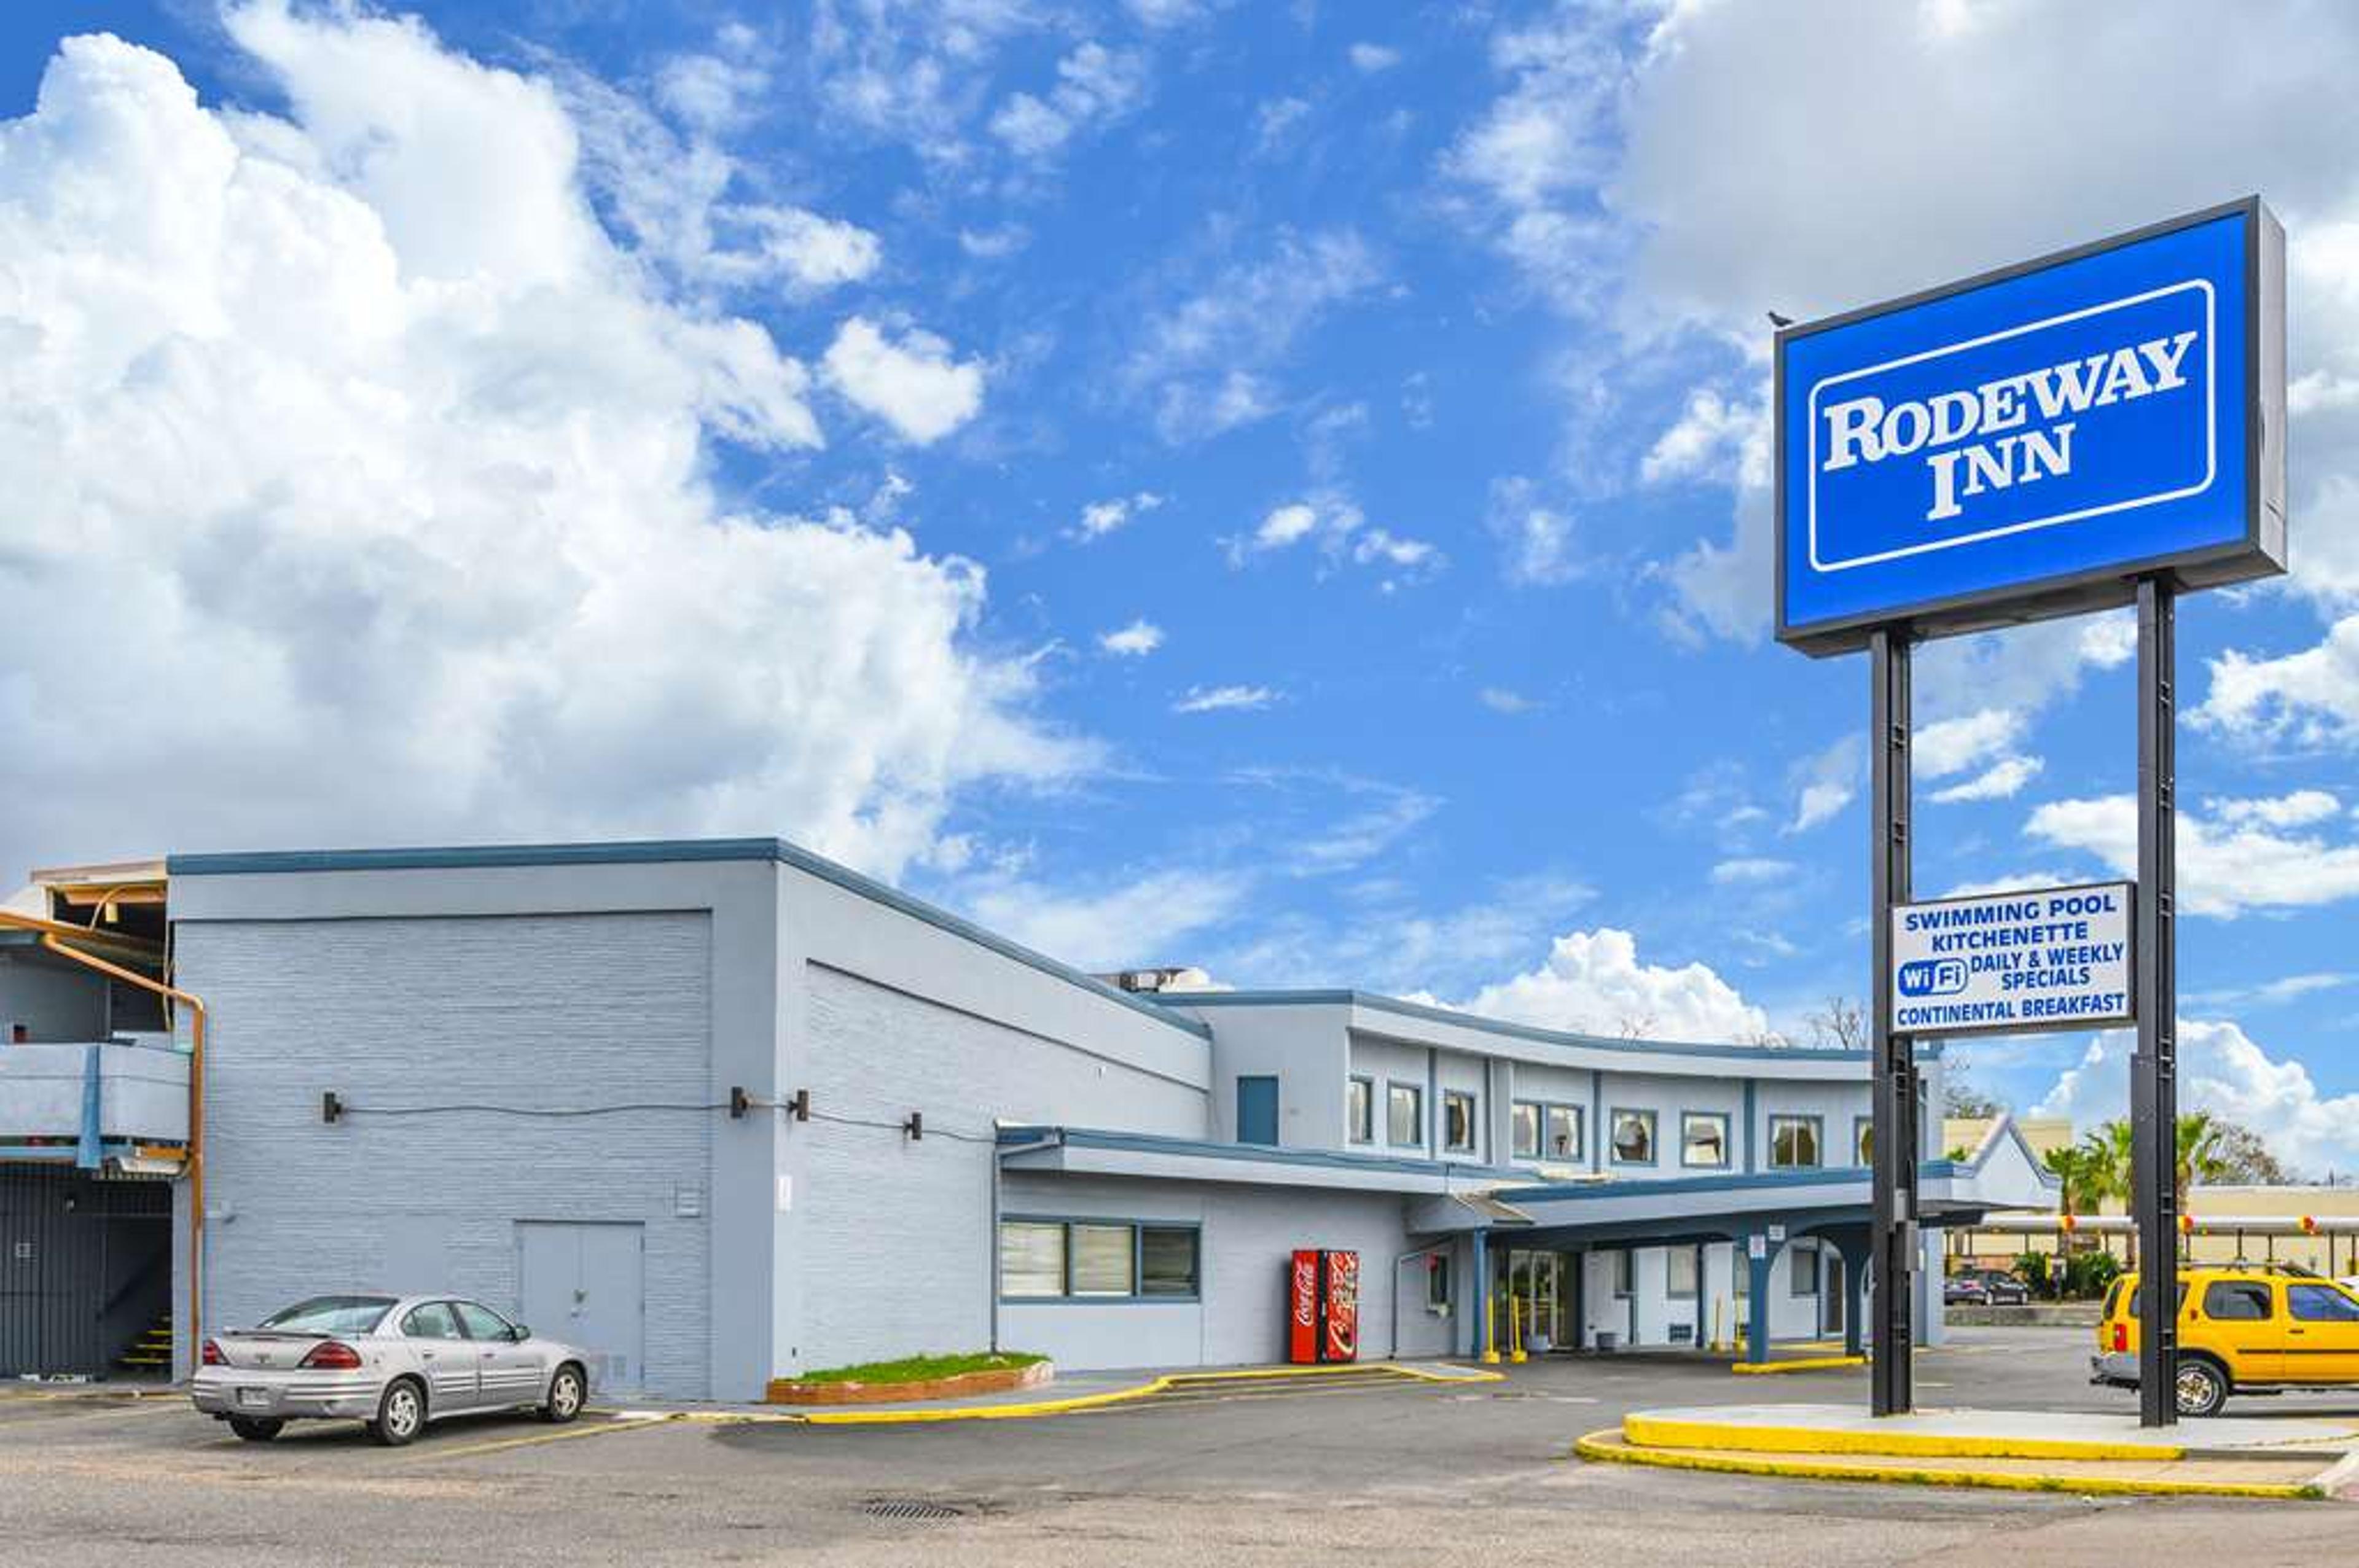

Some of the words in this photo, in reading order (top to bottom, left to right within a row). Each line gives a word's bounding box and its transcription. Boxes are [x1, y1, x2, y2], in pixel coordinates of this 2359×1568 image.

[1823, 331, 2198, 471] RODEWAY
[1927, 423, 2076, 521] INN
[1905, 901, 2040, 932] SWIMMING
[2049, 895, 2118, 917] POOL
[1931, 921, 2089, 953] KITCHENETTE
[1971, 952, 2022, 973] DAILY
[2028, 950, 2040, 968] &
[2048, 942, 2124, 966] WEEKLY
[2001, 967, 2091, 991] SPECIALS
[1897, 1000, 2016, 1026] CONTINENTAL
[2022, 993, 2126, 1018] BREAKFAST
